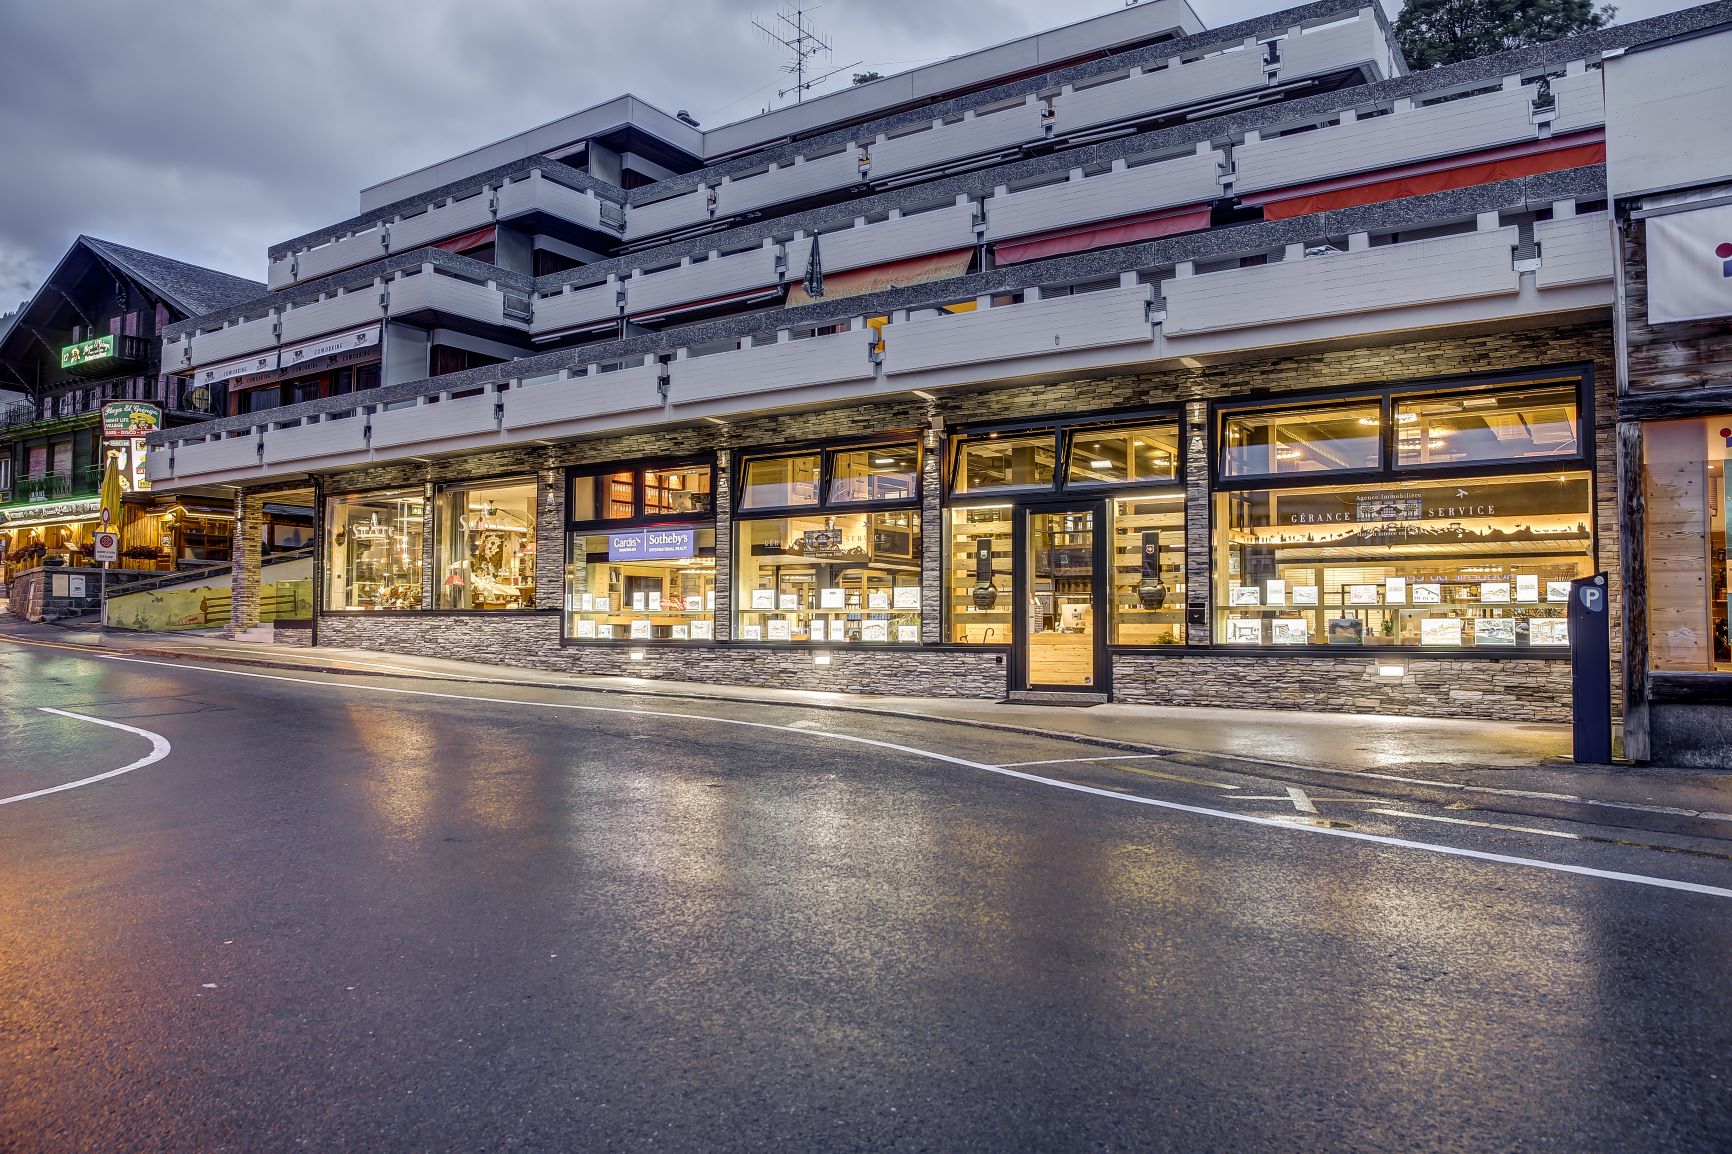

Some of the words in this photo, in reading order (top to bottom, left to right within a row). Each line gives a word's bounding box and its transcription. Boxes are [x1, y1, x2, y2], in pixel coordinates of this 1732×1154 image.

[314, 342, 343, 356] COWORKING
[1291, 512, 1351, 523] GÉRANCE
[1428, 505, 1495, 517] SERVICE
[613, 537, 637, 548] Cardis
[649, 532, 688, 546] Sotheby's
[1586, 588, 1600, 607] P
